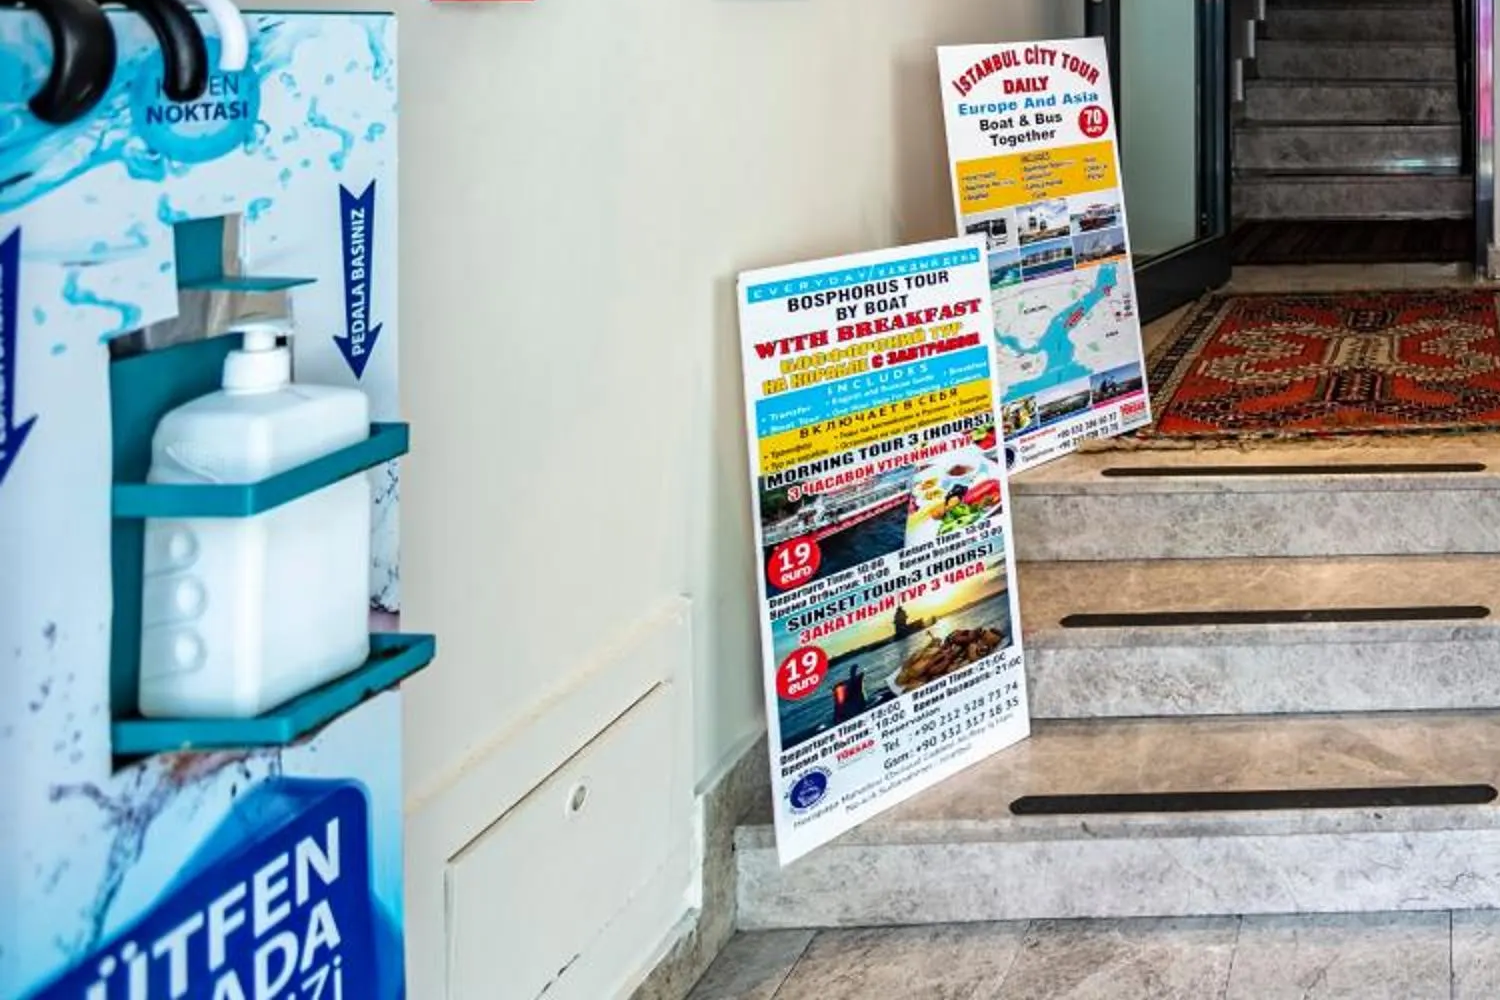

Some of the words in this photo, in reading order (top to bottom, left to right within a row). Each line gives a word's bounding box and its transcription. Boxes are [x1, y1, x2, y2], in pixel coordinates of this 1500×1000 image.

[1061, 52, 1101, 85] TOUR
[1003, 76, 1050, 94] DAILY
[146, 101, 249, 124] NOKTASI
[957, 101, 1017, 116] Europe
[1024, 93, 1056, 110] And
[1063, 91, 1099, 105] Asia
[1084, 109, 1103, 126] 70
[979, 116, 1014, 132] Boat
[1019, 114, 1030, 126] &
[1035, 112, 1063, 125] Bus
[990, 128, 1056, 147] Together
[351, 207, 366, 281] BASINIZ
[787, 279, 899, 313] BOSPHORUS
[904, 270, 949, 290] TOUR
[351, 283, 366, 357] PEDALA
[836, 305, 858, 321] BY
[865, 294, 909, 315] BOAT
[754, 330, 829, 360] WITH
[836, 298, 982, 342] BREAKFAST
[827, 363, 928, 396] INCLUDES
[767, 452, 855, 488] MORNING
[859, 437, 905, 461] TOUR
[908, 433, 919, 446] 3
[778, 541, 812, 572] 19
[781, 565, 813, 585] euro
[900, 583, 927, 603] ТУР
[944, 561, 985, 584] ЧАСА
[787, 593, 857, 632] SUNSET
[863, 574, 907, 602] TOUR
[911, 569, 922, 583] 3
[785, 651, 818, 682] 19
[788, 674, 820, 696] euro
[881, 706, 941, 739] Reservation
[940, 708, 961, 727] 212
[779, 732, 836, 765] Departure
